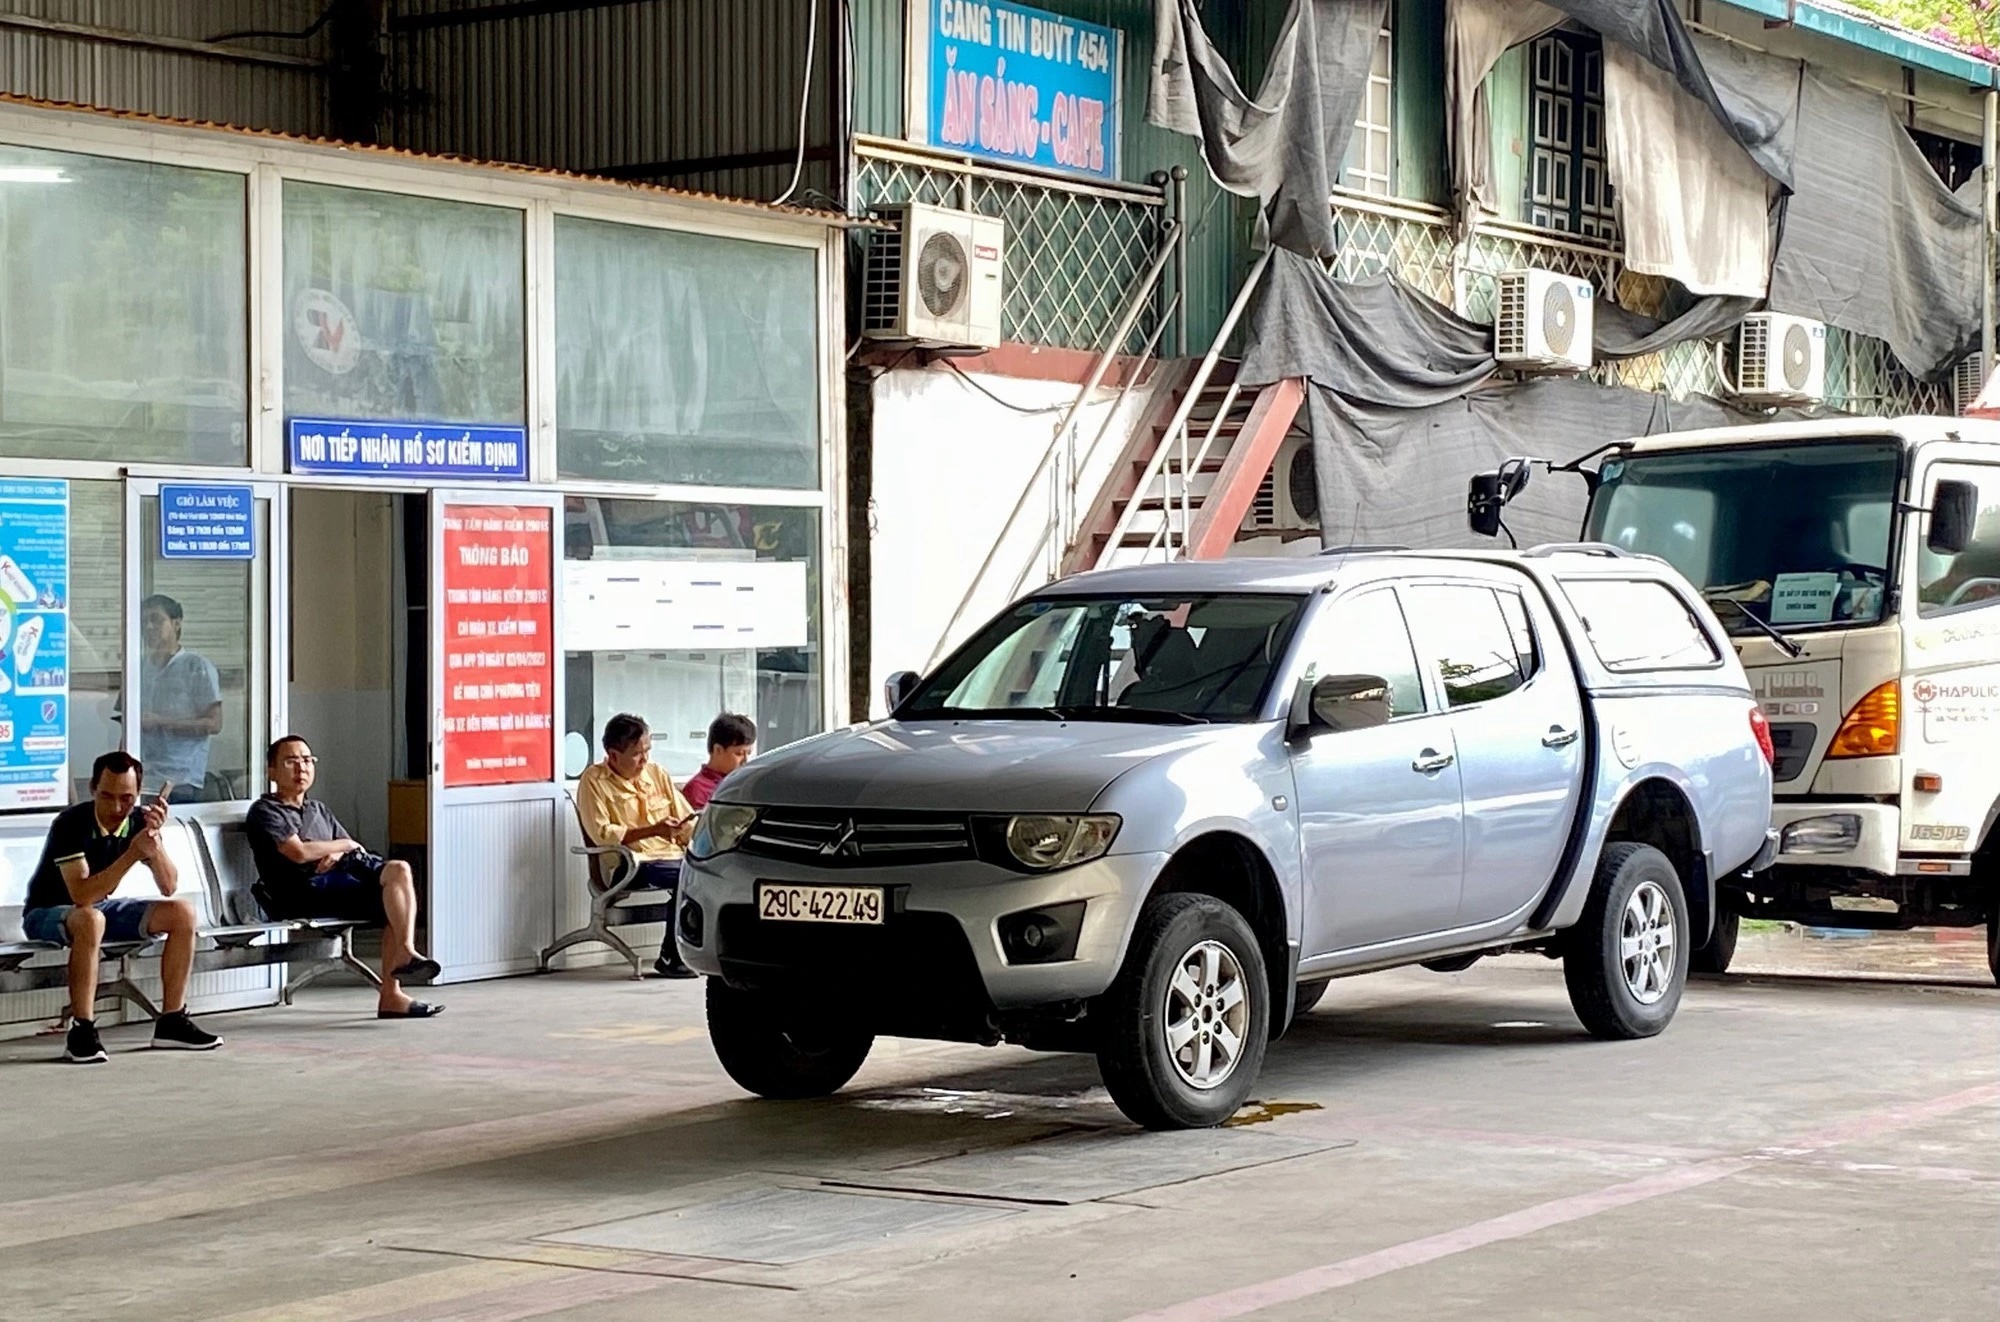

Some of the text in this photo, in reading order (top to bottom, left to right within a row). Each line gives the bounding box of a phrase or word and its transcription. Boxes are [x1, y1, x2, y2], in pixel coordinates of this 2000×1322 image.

[996, 9, 1026, 54] TIN
[1030, 15, 1075, 65] BUÝT
[1077, 30, 1109, 74] 454
[942, 45, 978, 147] ĂN
[300, 428, 517, 471] NƠI TIẾP NHẬN HỒ SƠ KIỂM ĐỊNH
[176, 492, 240, 509] GIỜ LÀM VIỆC
[459, 542, 529, 567] THÔNG BÁO
[1763, 671, 1818, 698] TURBO
